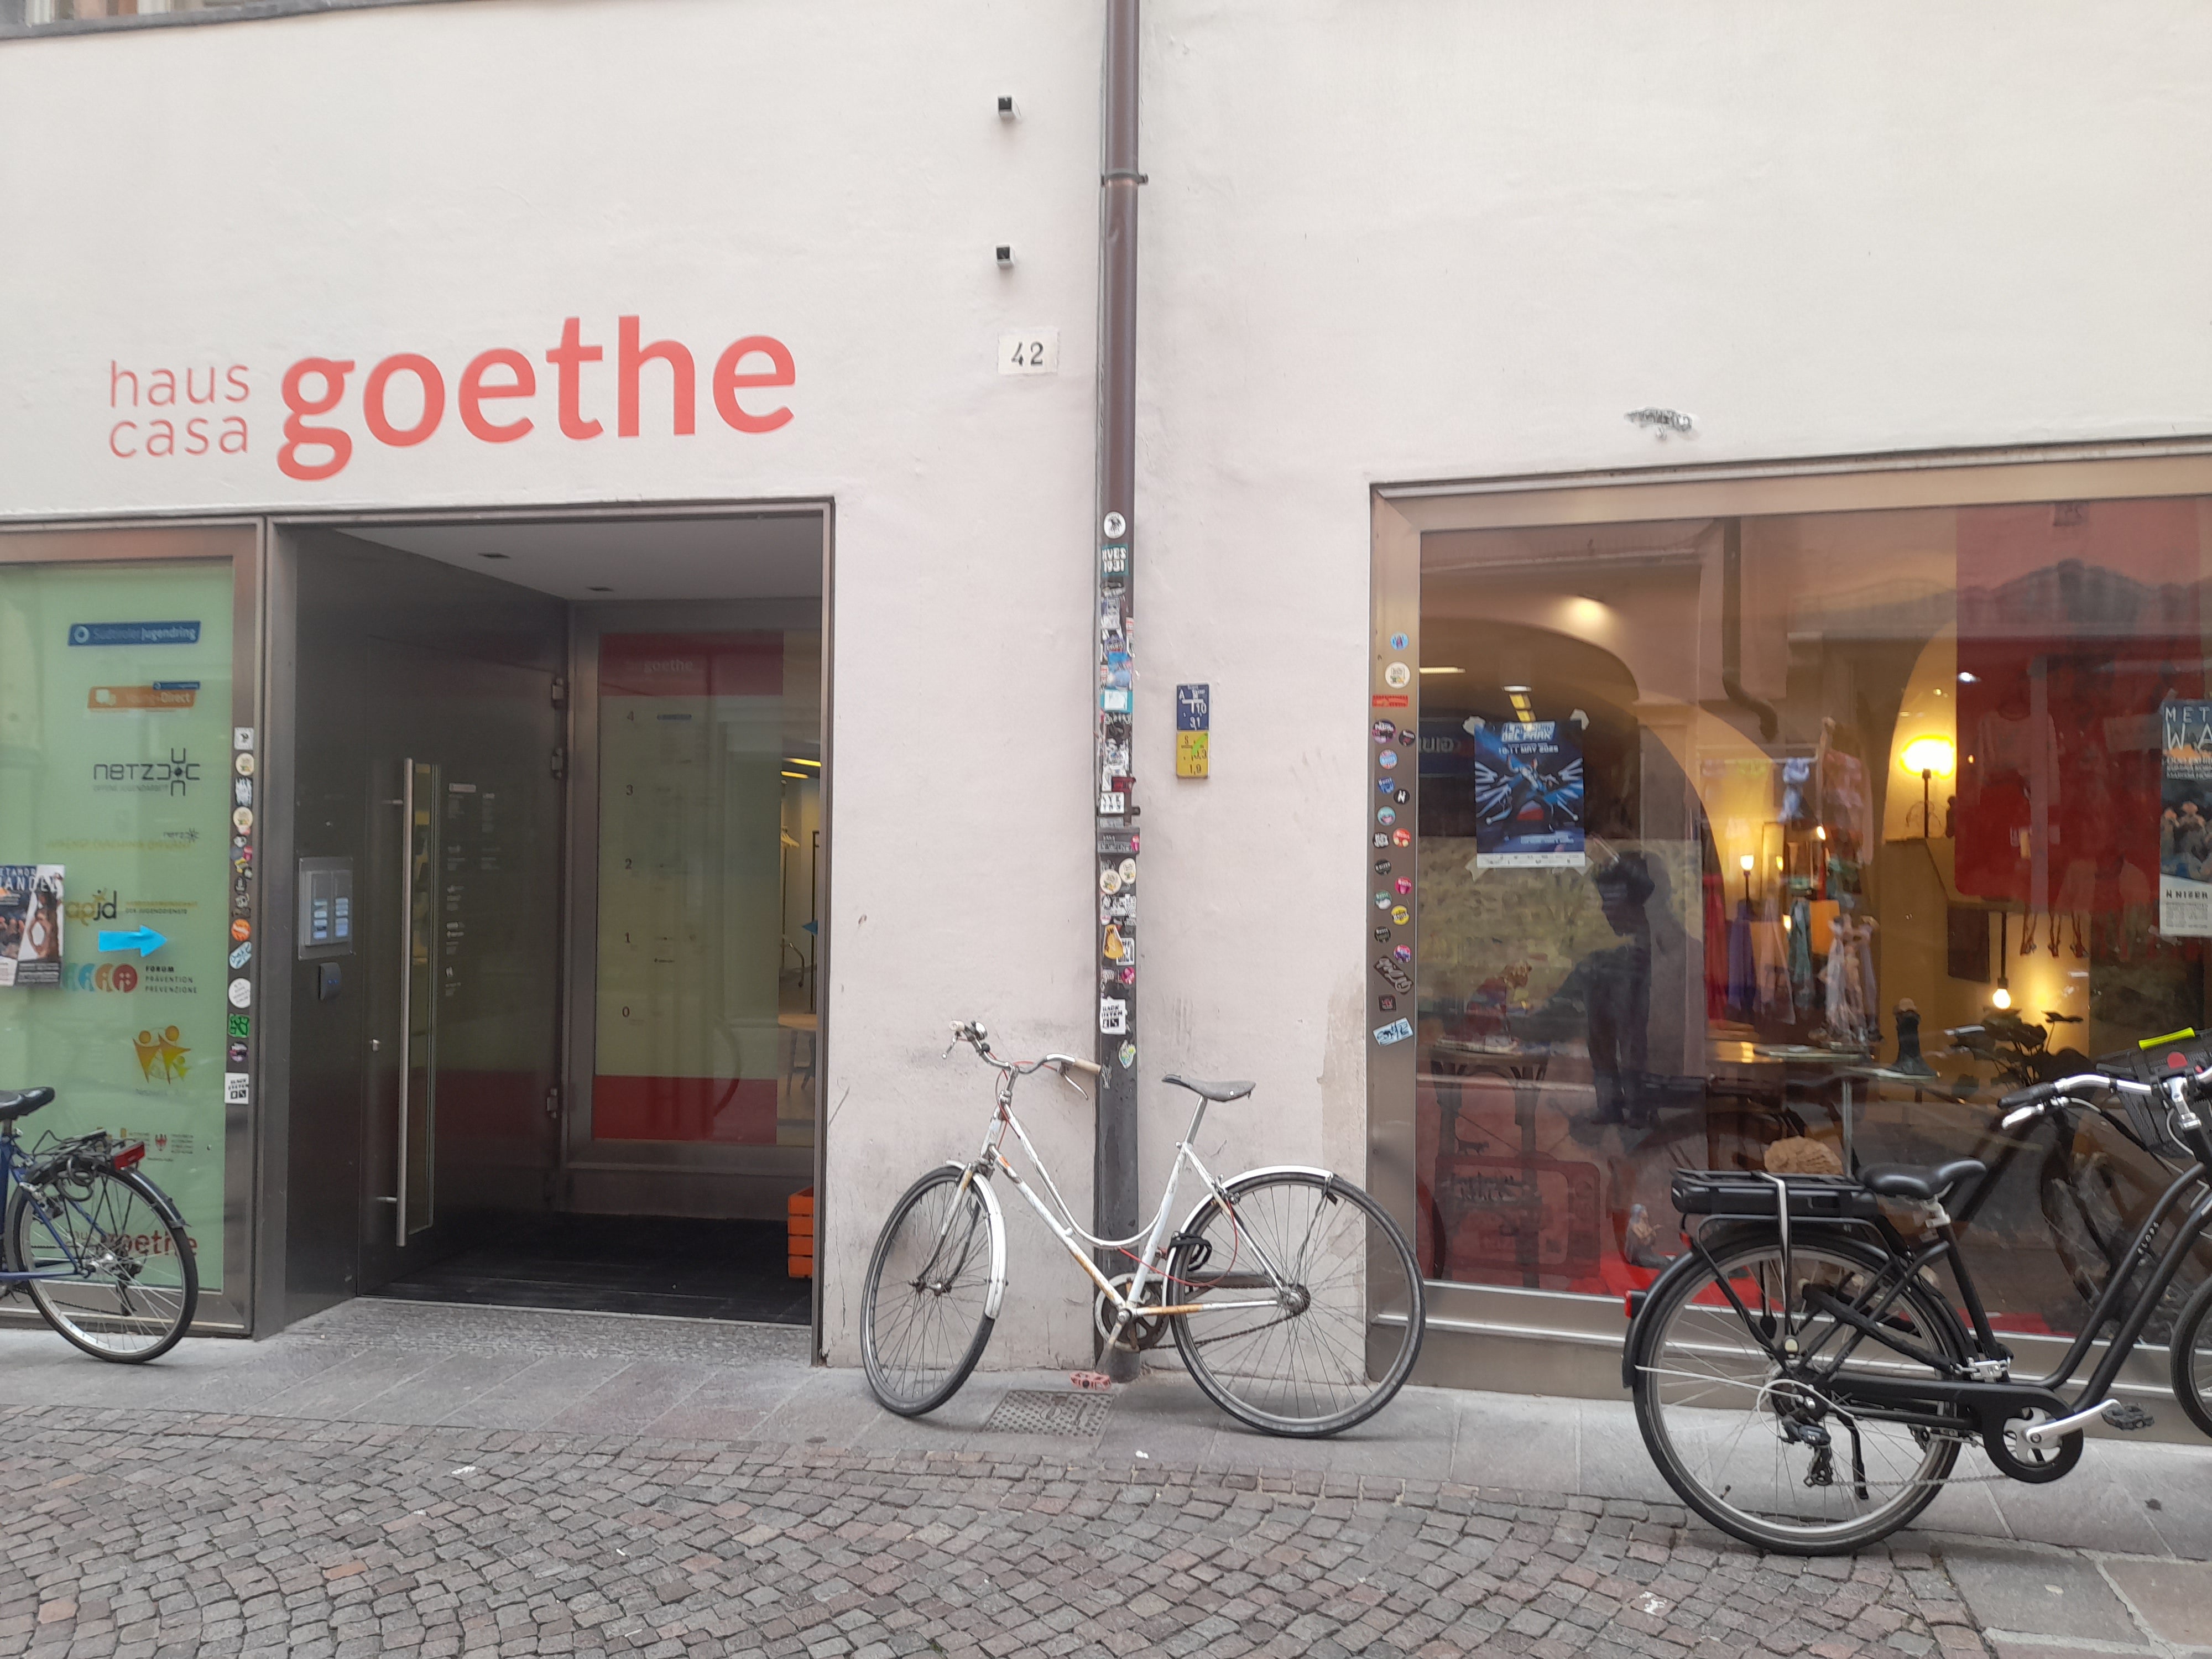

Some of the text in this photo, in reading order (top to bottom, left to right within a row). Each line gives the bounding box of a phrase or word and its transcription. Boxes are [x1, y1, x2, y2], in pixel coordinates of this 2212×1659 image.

[1011, 341, 1044, 367] 42
[109, 359, 251, 408] haus
[276, 315, 797, 483] goethe
[108, 415, 249, 458] casa
[626, 784, 633, 796] 3
[625, 858, 632, 870] 2
[625, 932, 630, 943] 1
